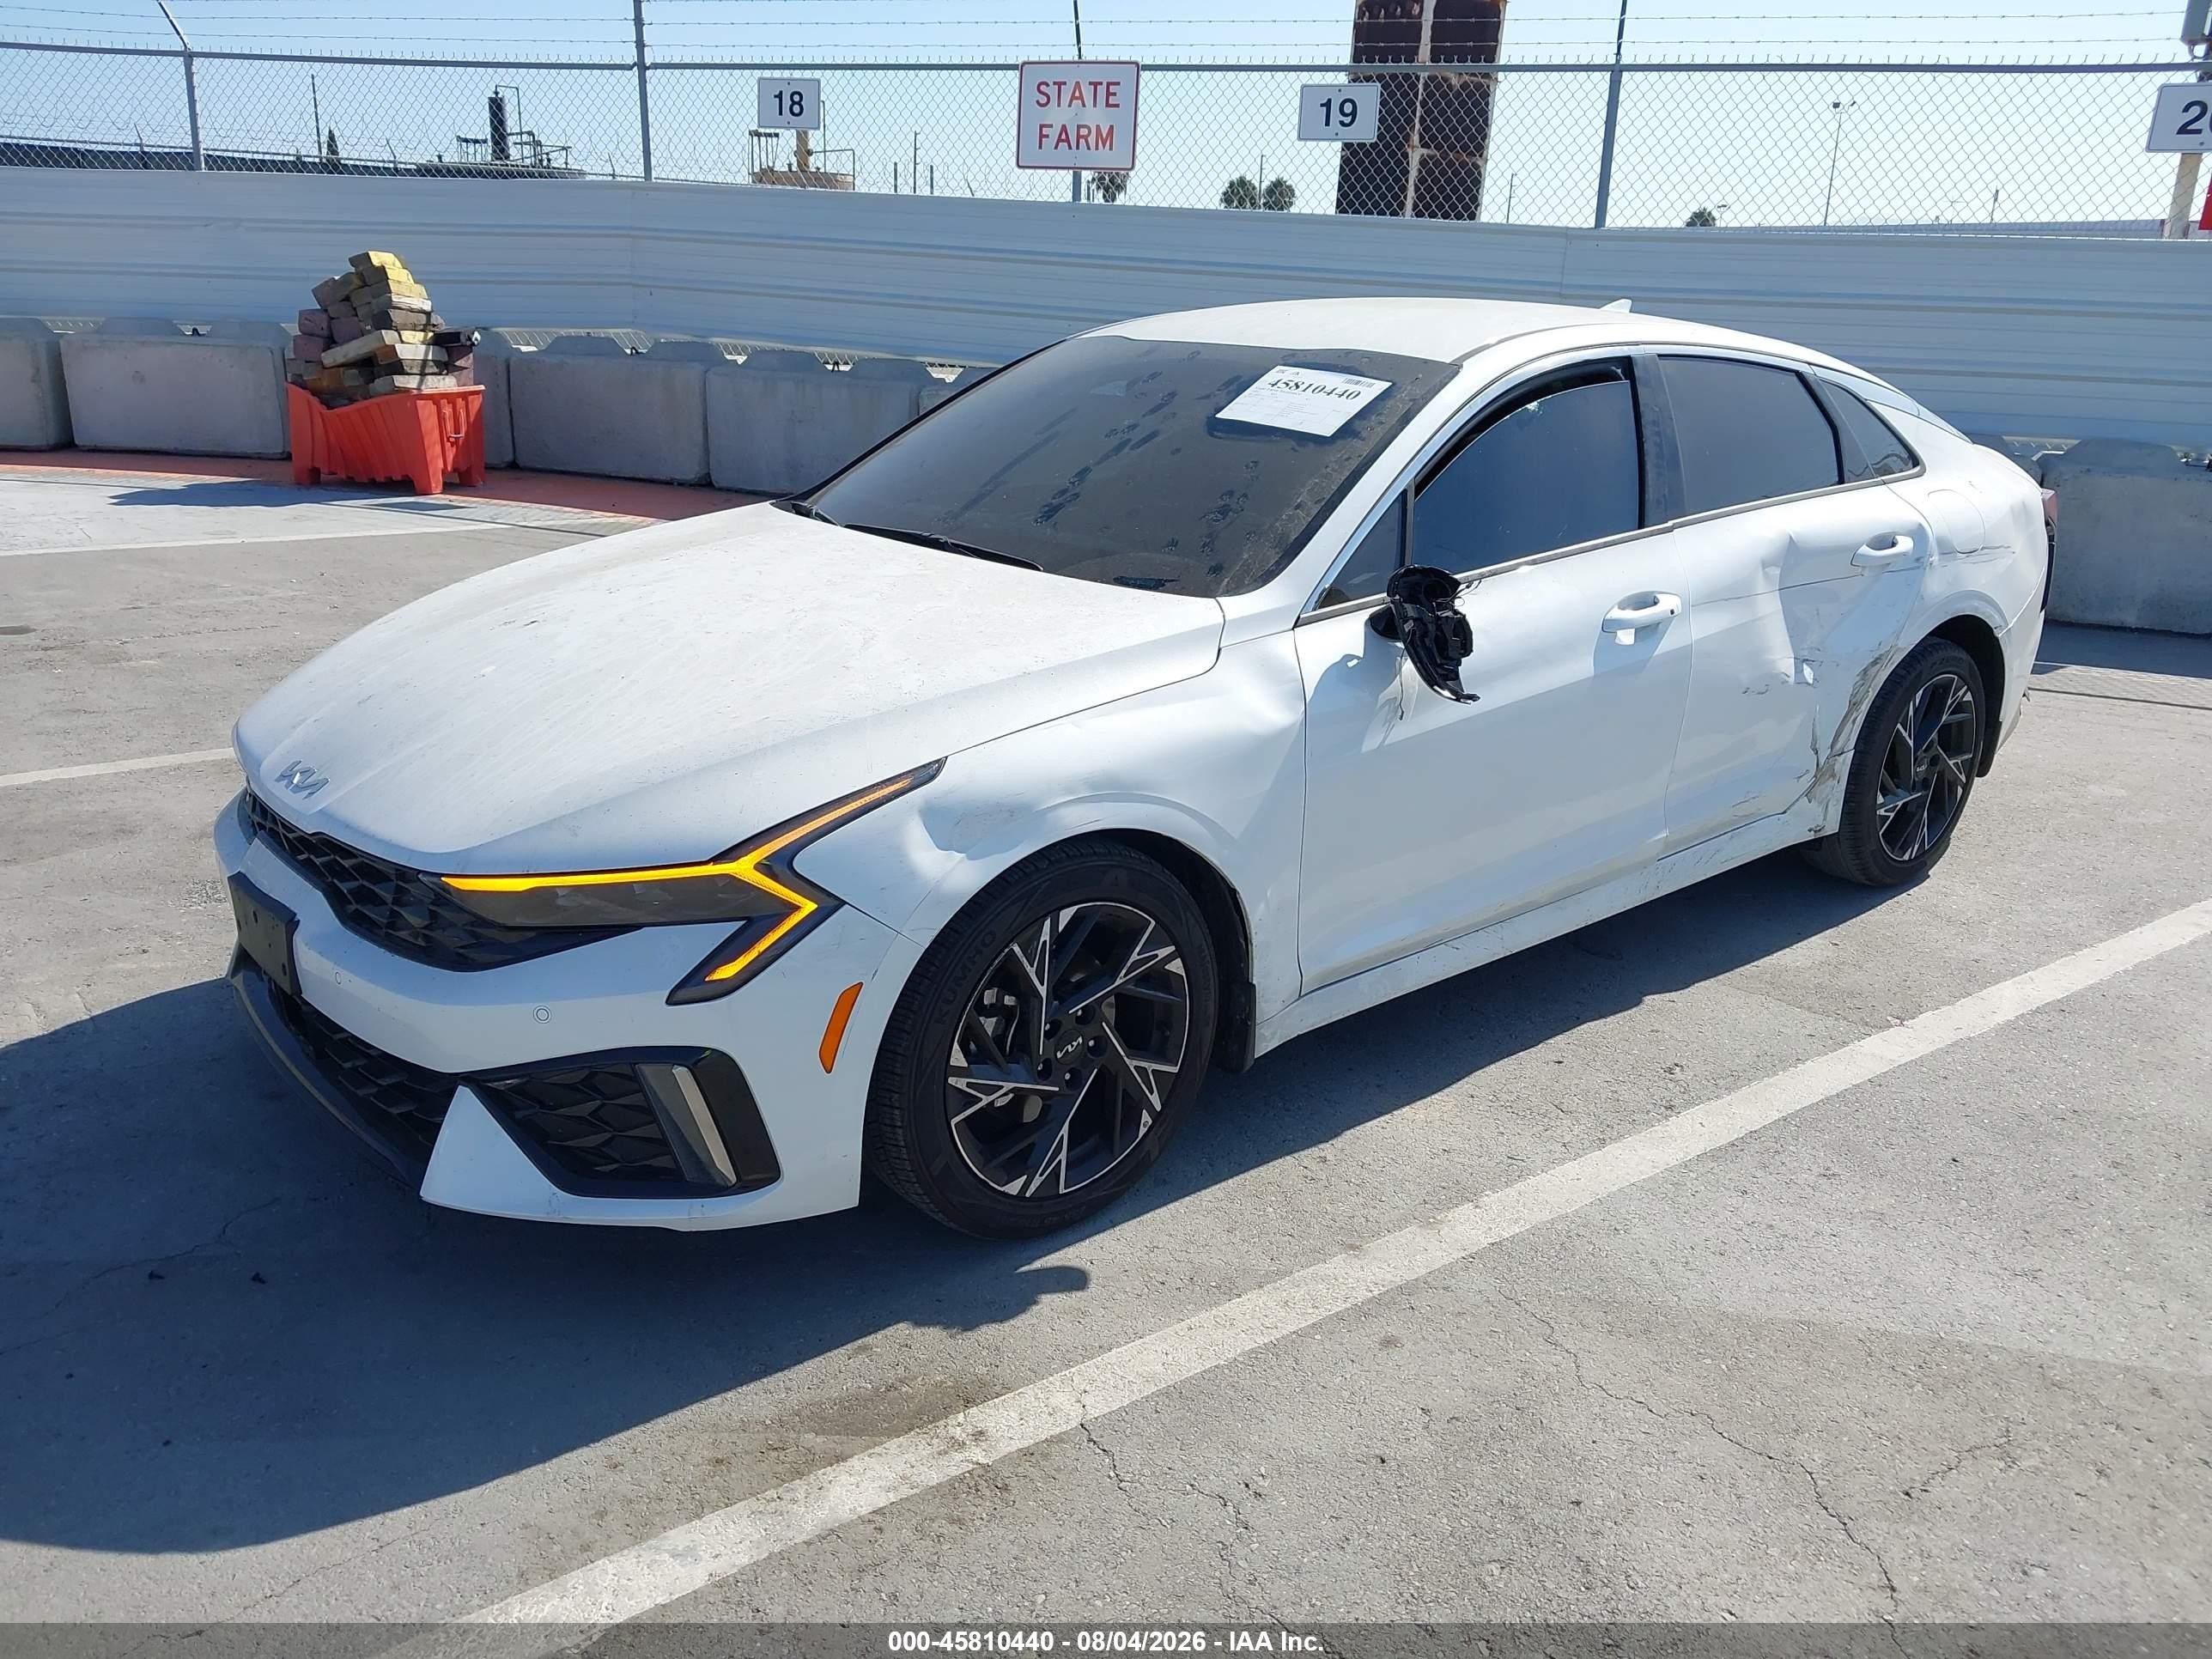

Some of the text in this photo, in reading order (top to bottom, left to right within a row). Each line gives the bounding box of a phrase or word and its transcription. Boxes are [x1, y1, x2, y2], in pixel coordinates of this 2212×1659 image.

[775, 90, 805, 117] 18
[1036, 82, 1121, 108] STATE
[1320, 98, 1358, 128] 19
[2176, 100, 2212, 135] 2
[1037, 125, 1115, 151] FARM
[1268, 378, 1361, 400] 45810440
